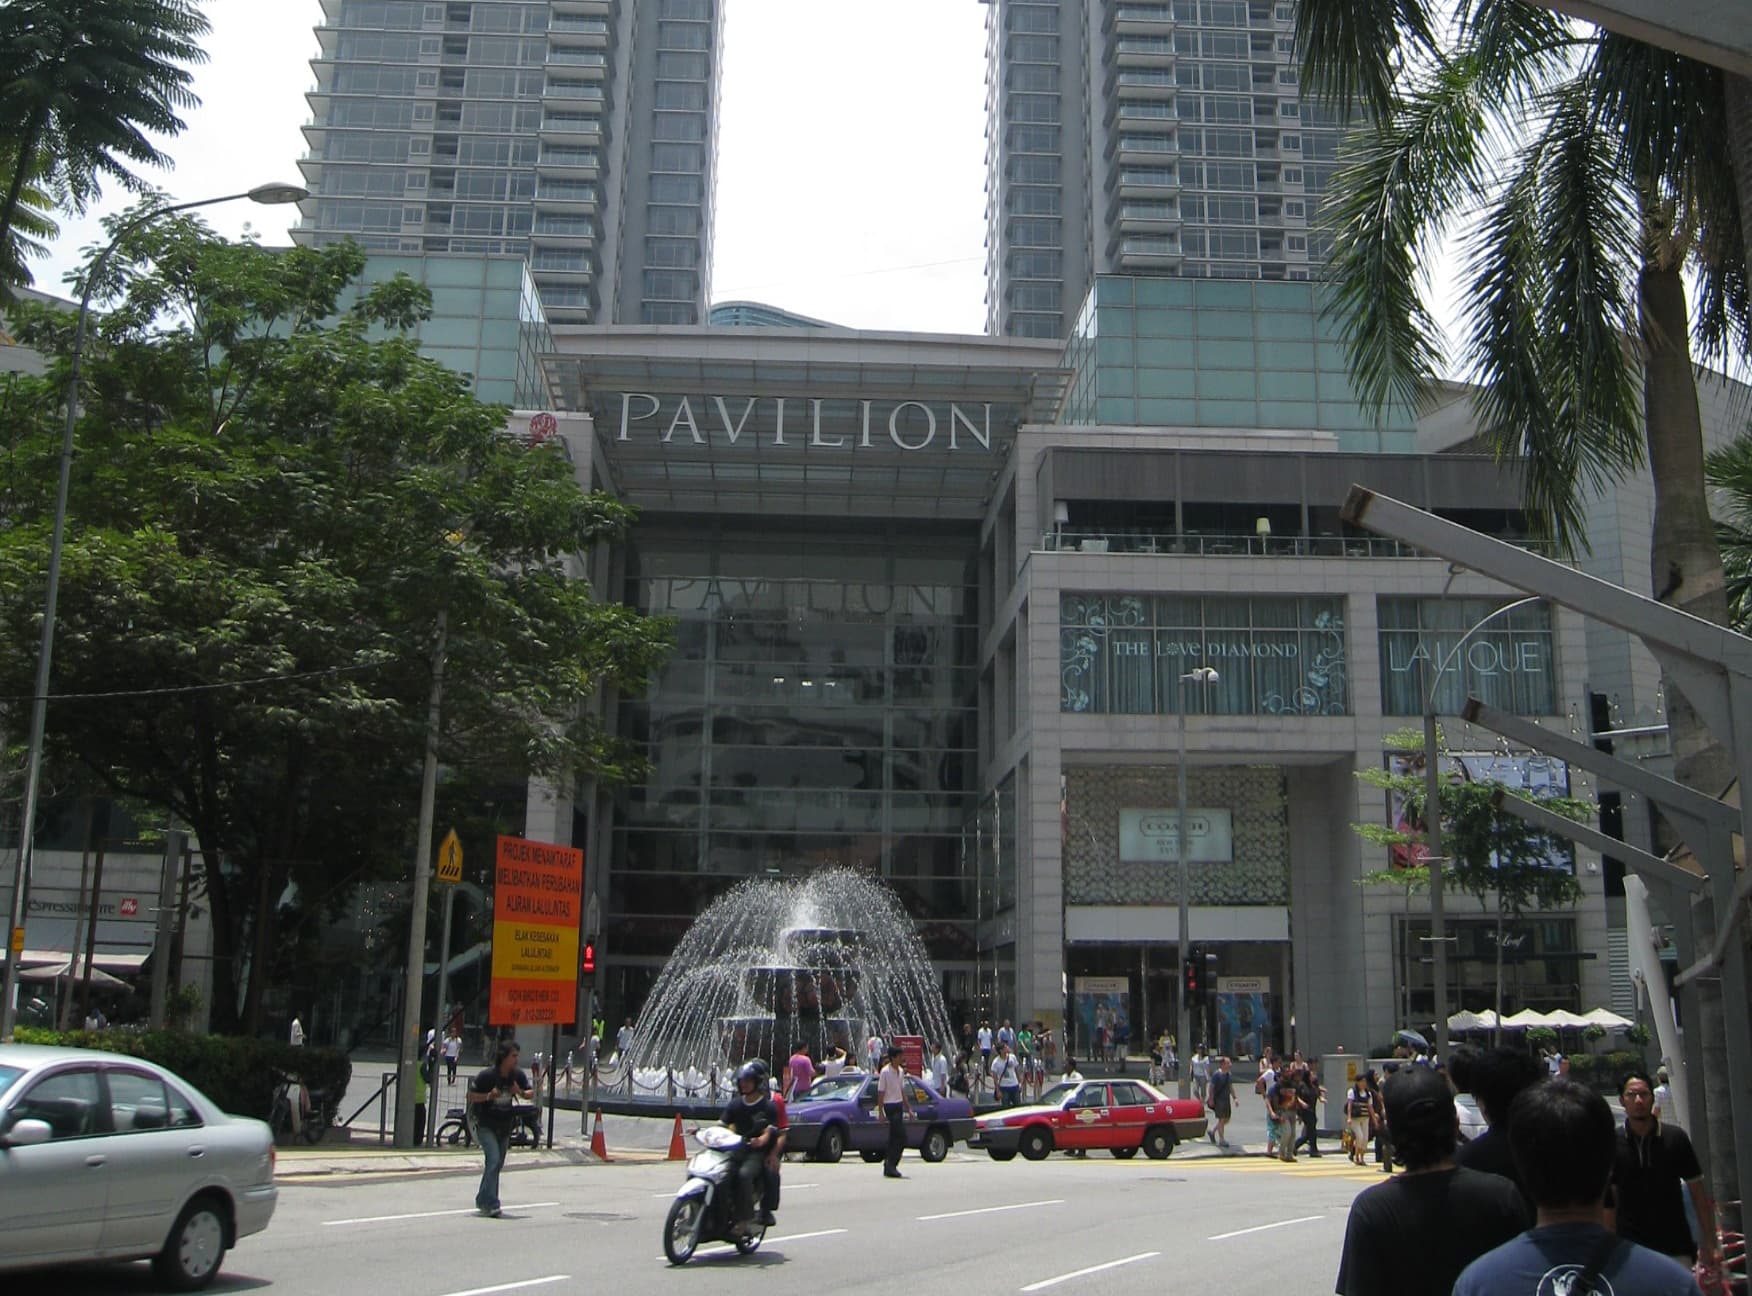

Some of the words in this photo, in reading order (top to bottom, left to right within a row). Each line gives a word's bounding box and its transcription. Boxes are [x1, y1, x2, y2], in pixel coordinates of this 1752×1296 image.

[617, 392, 992, 450] PAVILION
[1113, 641, 1148, 656] THE
[1208, 642, 1298, 657] DIAMOND
[1389, 641, 1542, 675] LALIQUE
[1146, 823, 1204, 831] COAH
